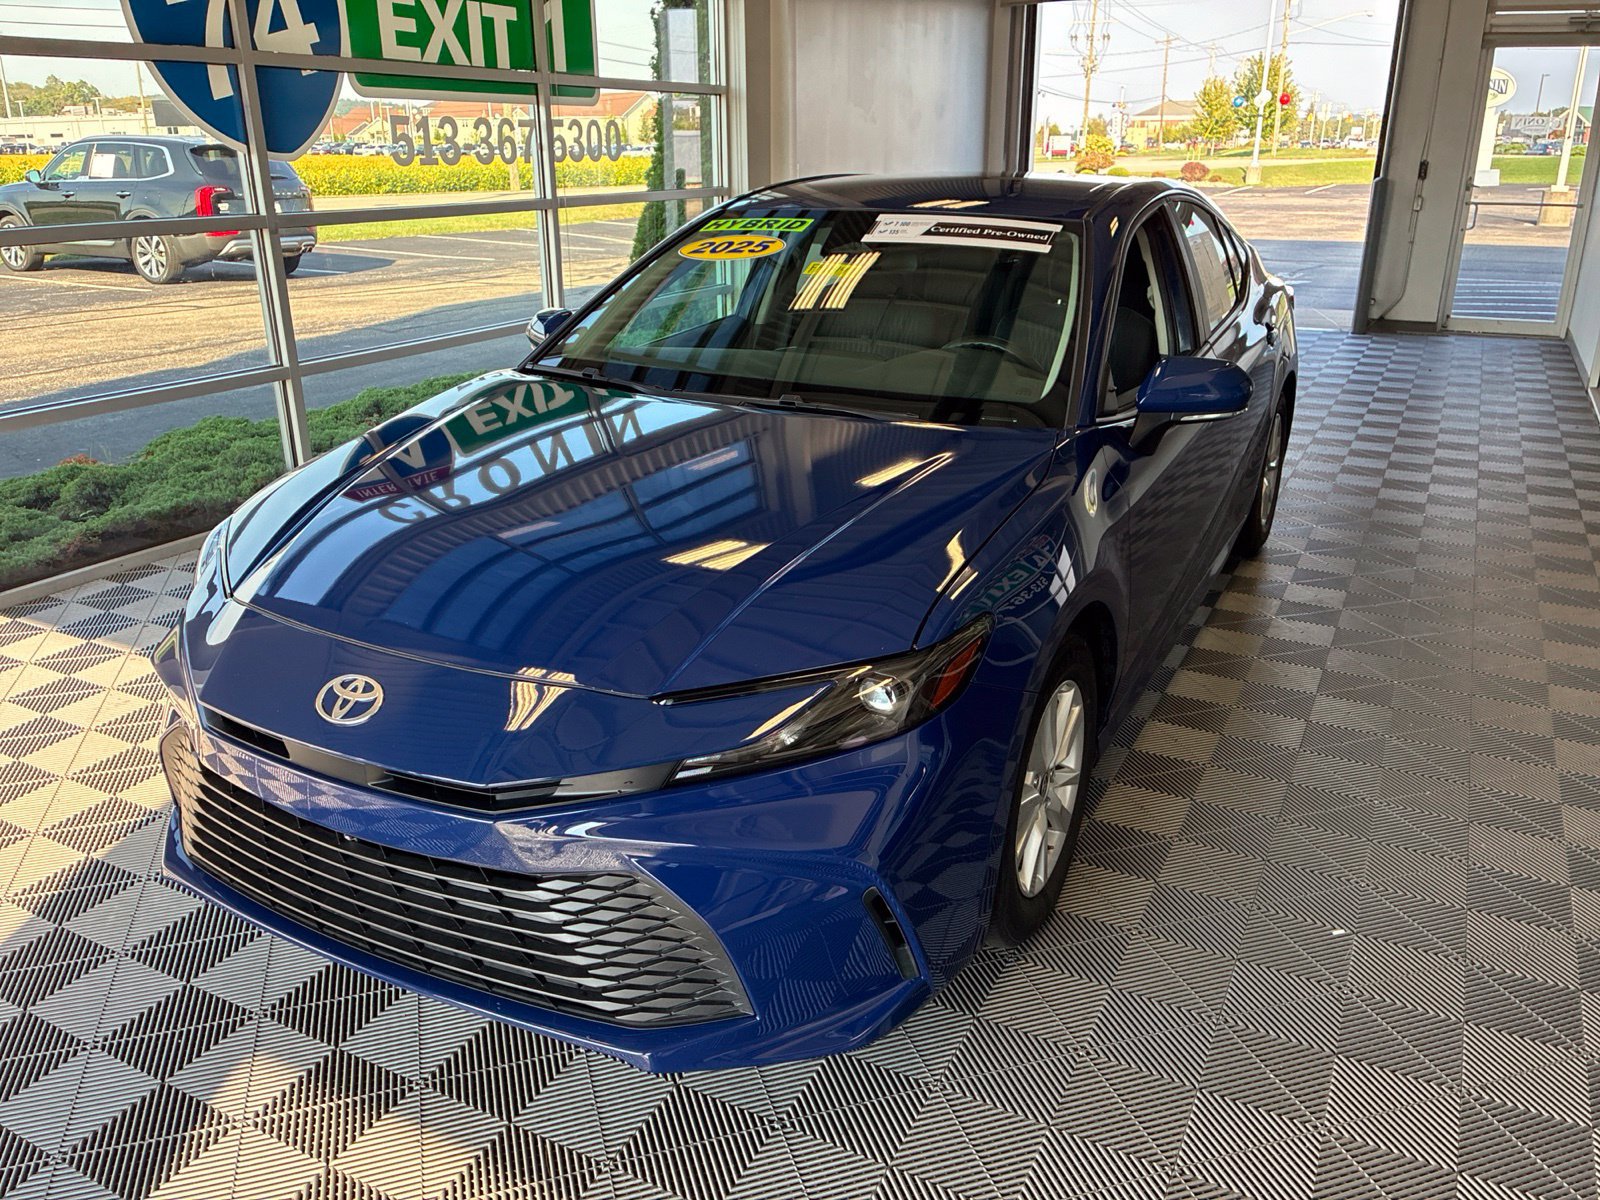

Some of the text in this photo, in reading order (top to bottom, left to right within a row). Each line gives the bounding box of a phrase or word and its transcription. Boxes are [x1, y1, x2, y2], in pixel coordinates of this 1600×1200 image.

[377, 0, 517, 69] EXIT
[703, 219, 807, 230] HYBRID
[930, 225, 1050, 241] Certified Pre-Owned
[687, 240, 778, 254] 2025
